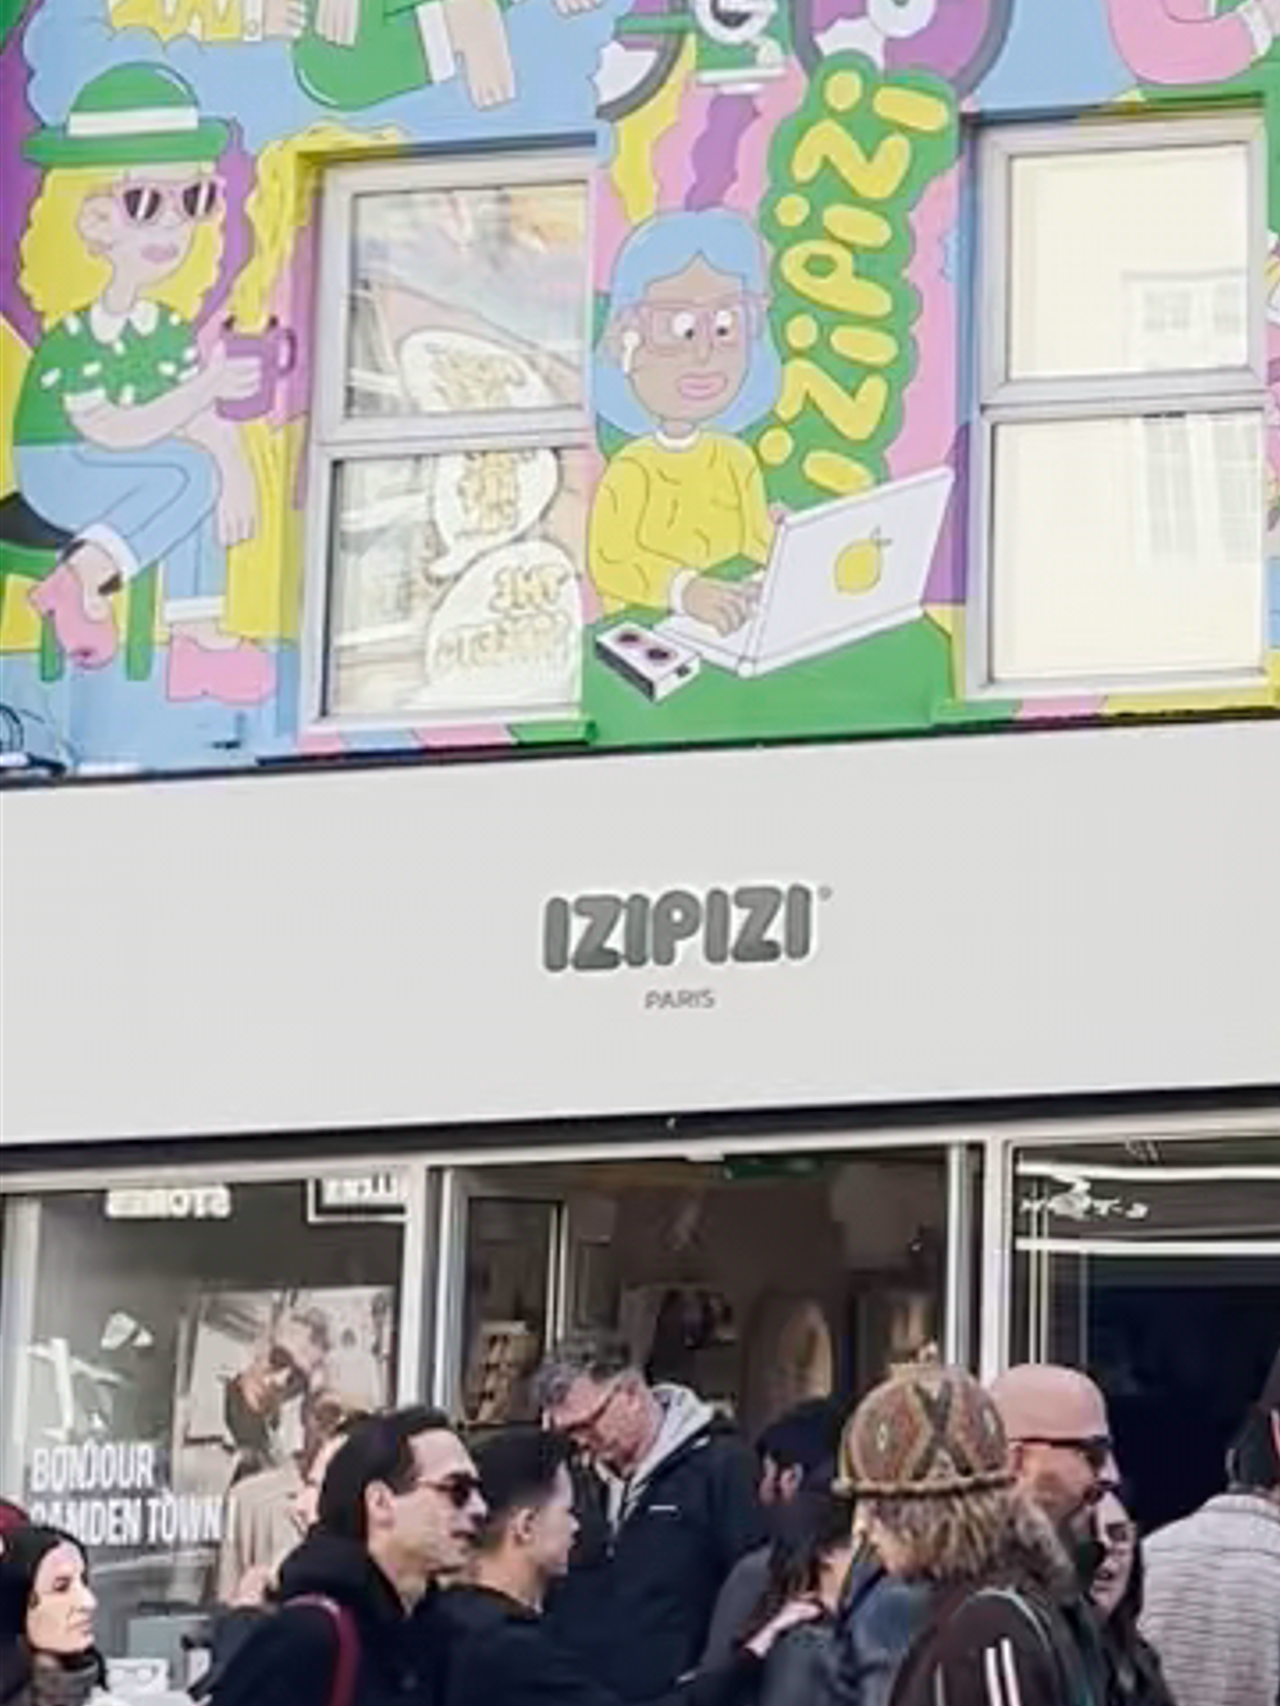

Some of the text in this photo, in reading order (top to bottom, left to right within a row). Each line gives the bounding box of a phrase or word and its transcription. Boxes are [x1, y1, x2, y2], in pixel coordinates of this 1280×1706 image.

[543, 884, 812, 973] IZIPIZI
[644, 989, 716, 1010] PARIS
[31, 1442, 154, 1492] BONJOUR
[146, 1495, 223, 1543] TOWN
